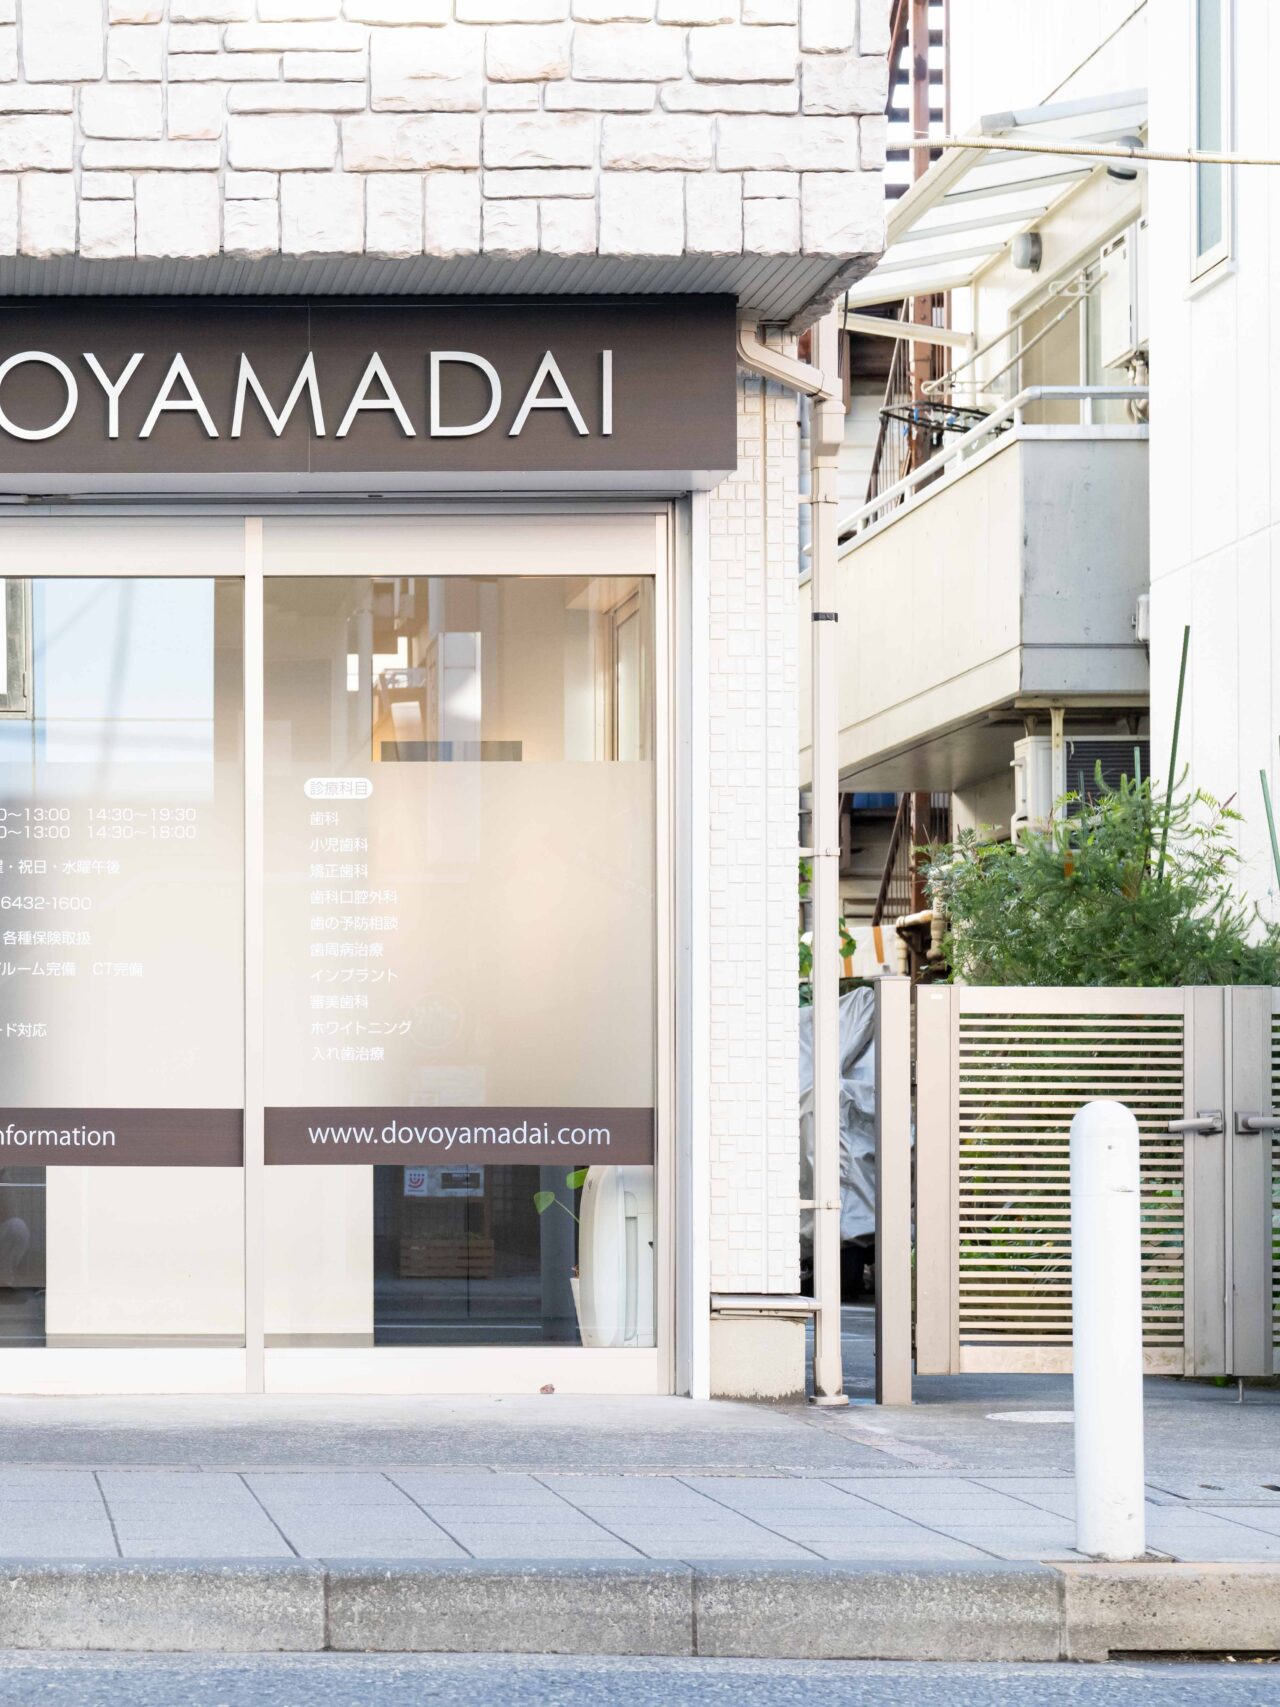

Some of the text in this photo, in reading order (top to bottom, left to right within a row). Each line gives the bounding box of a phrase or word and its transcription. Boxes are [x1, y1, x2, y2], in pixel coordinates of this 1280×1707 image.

[309, 781, 369, 796] 診療科目
[309, 811, 339, 826] 歯科
[309, 837, 369, 853] 小児歯科
[309, 863, 369, 879] 矯正歯科
[309, 889, 399, 905] 歯科口腔外科
[309, 916, 399, 932] 歯の予防相談
[309, 942, 385, 958] 歯周病治療
[92, 961, 144, 977] CT完備
[310, 968, 399, 983] インプラント
[309, 994, 369, 1010] 審美歯科
[311, 1020, 413, 1036] ホワイトニング
[311, 1046, 385, 1062] 入れ歯治療
[308, 1120, 611, 1150] www.dovoyamadai.com
